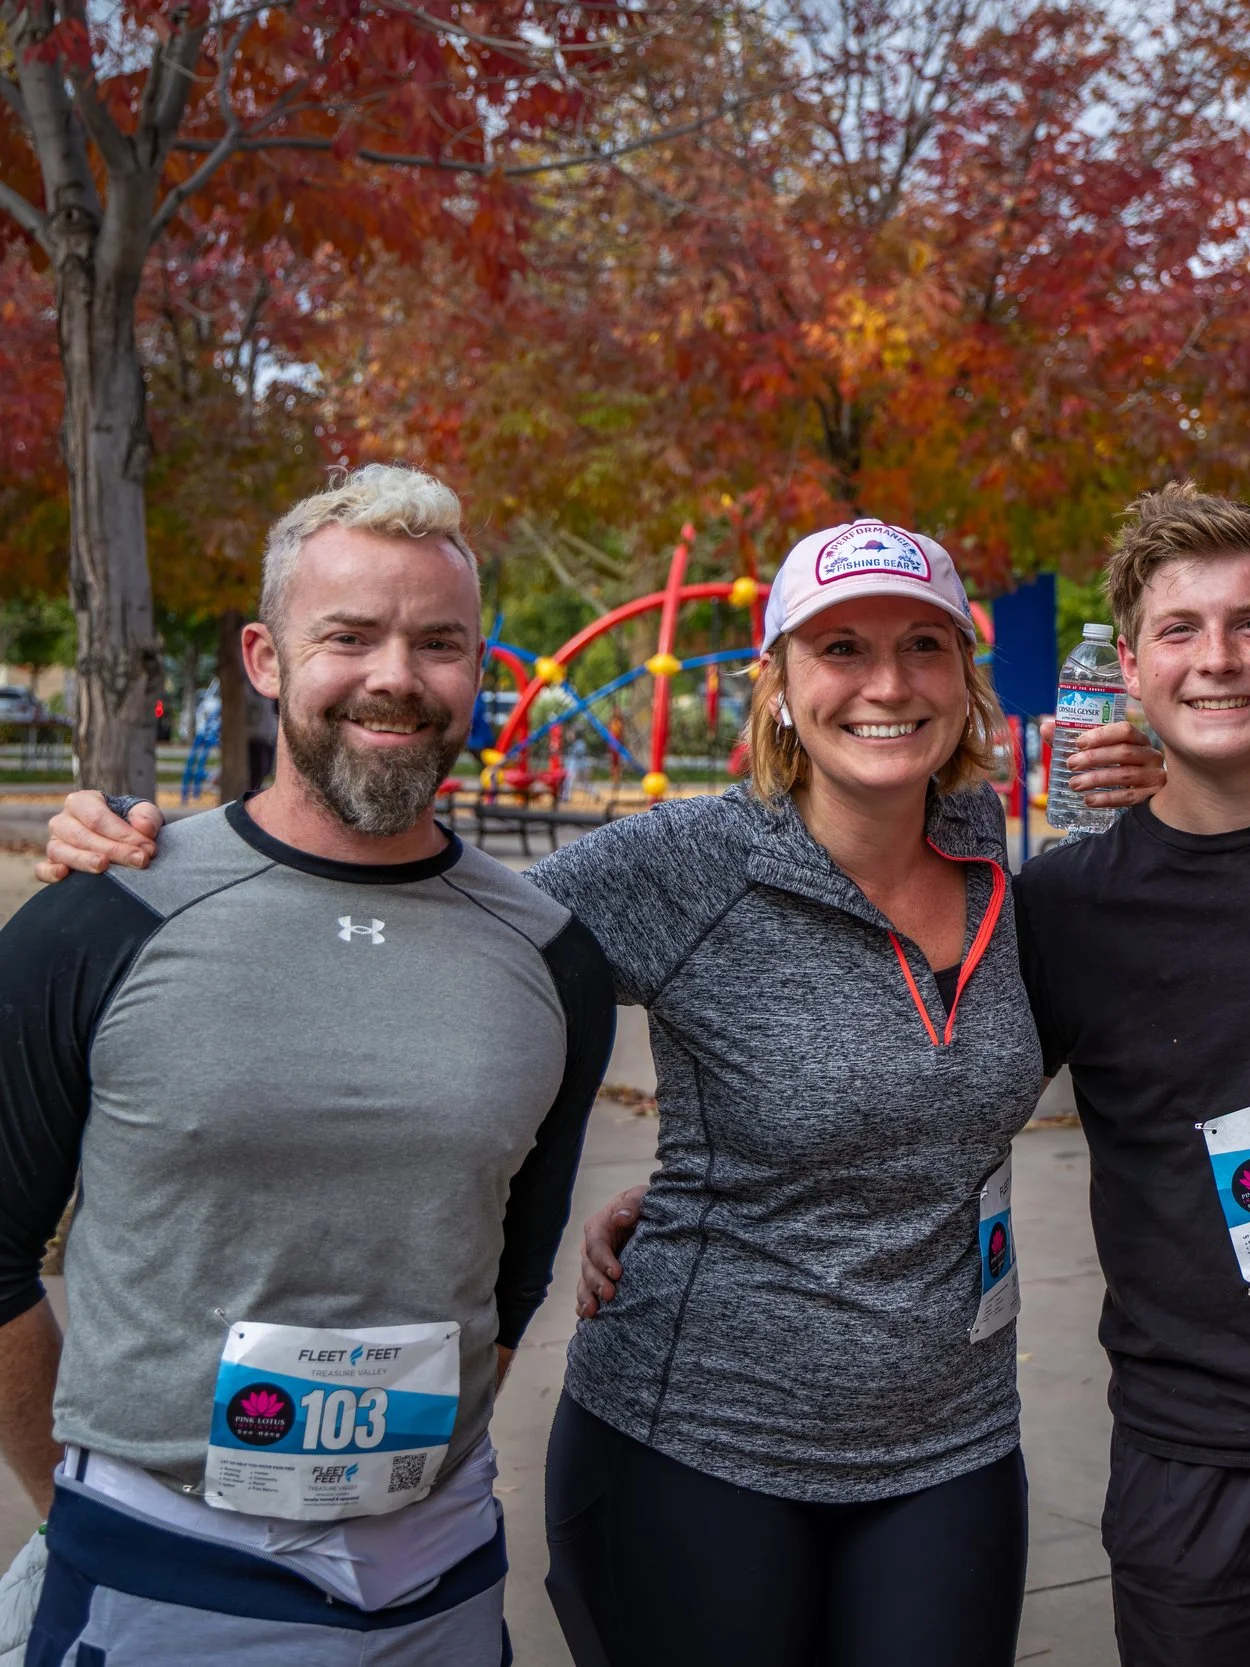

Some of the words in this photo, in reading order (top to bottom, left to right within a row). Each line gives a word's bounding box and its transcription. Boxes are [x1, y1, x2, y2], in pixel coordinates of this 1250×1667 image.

[831, 527, 911, 550] PERFORMANCE
[837, 558, 880, 572] FISHING
[884, 558, 910, 570] GEAR
[1077, 708, 1099, 716] GEYSER
[298, 1349, 347, 1362] FLEET
[366, 1347, 402, 1360] FEET
[358, 1368, 387, 1376] VALLEY
[300, 1387, 389, 1450] 103
[312, 1466, 347, 1475] FLEET
[314, 1474, 343, 1483] FEET
